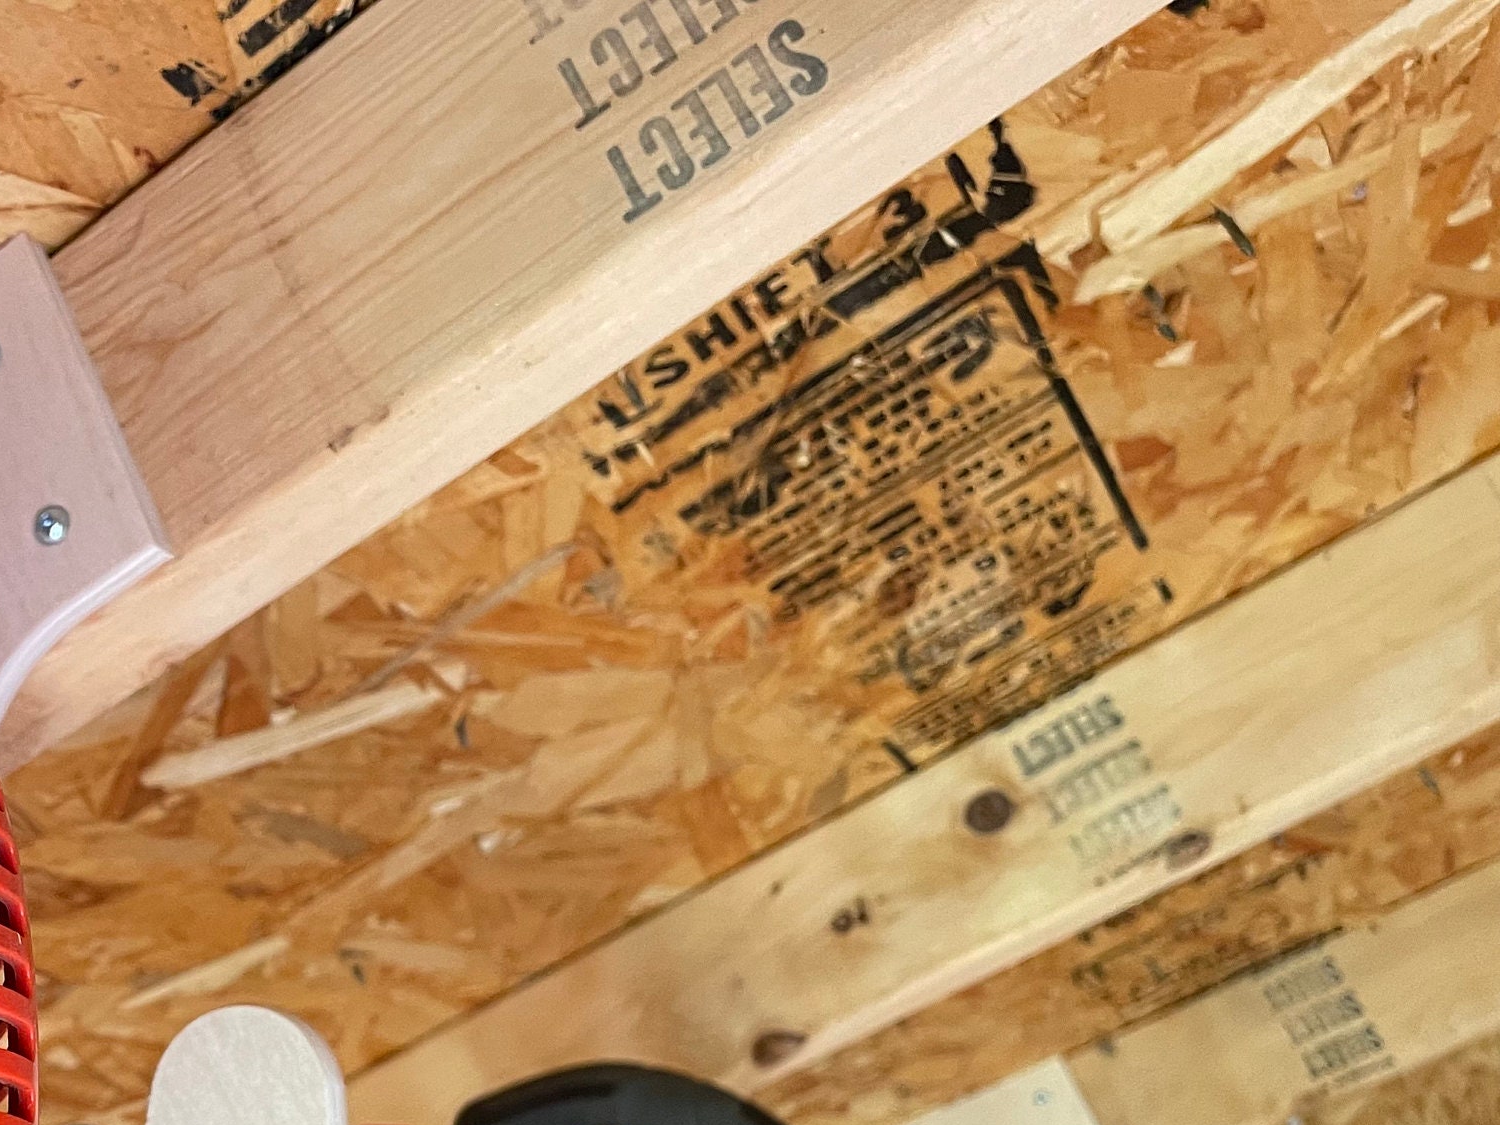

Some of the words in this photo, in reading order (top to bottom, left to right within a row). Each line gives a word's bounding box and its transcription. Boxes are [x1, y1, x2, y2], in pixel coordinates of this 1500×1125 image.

[557, 0, 750, 131] ELECT
[606, 19, 829, 224] SELECT
[1012, 694, 1125, 777] SELECT
